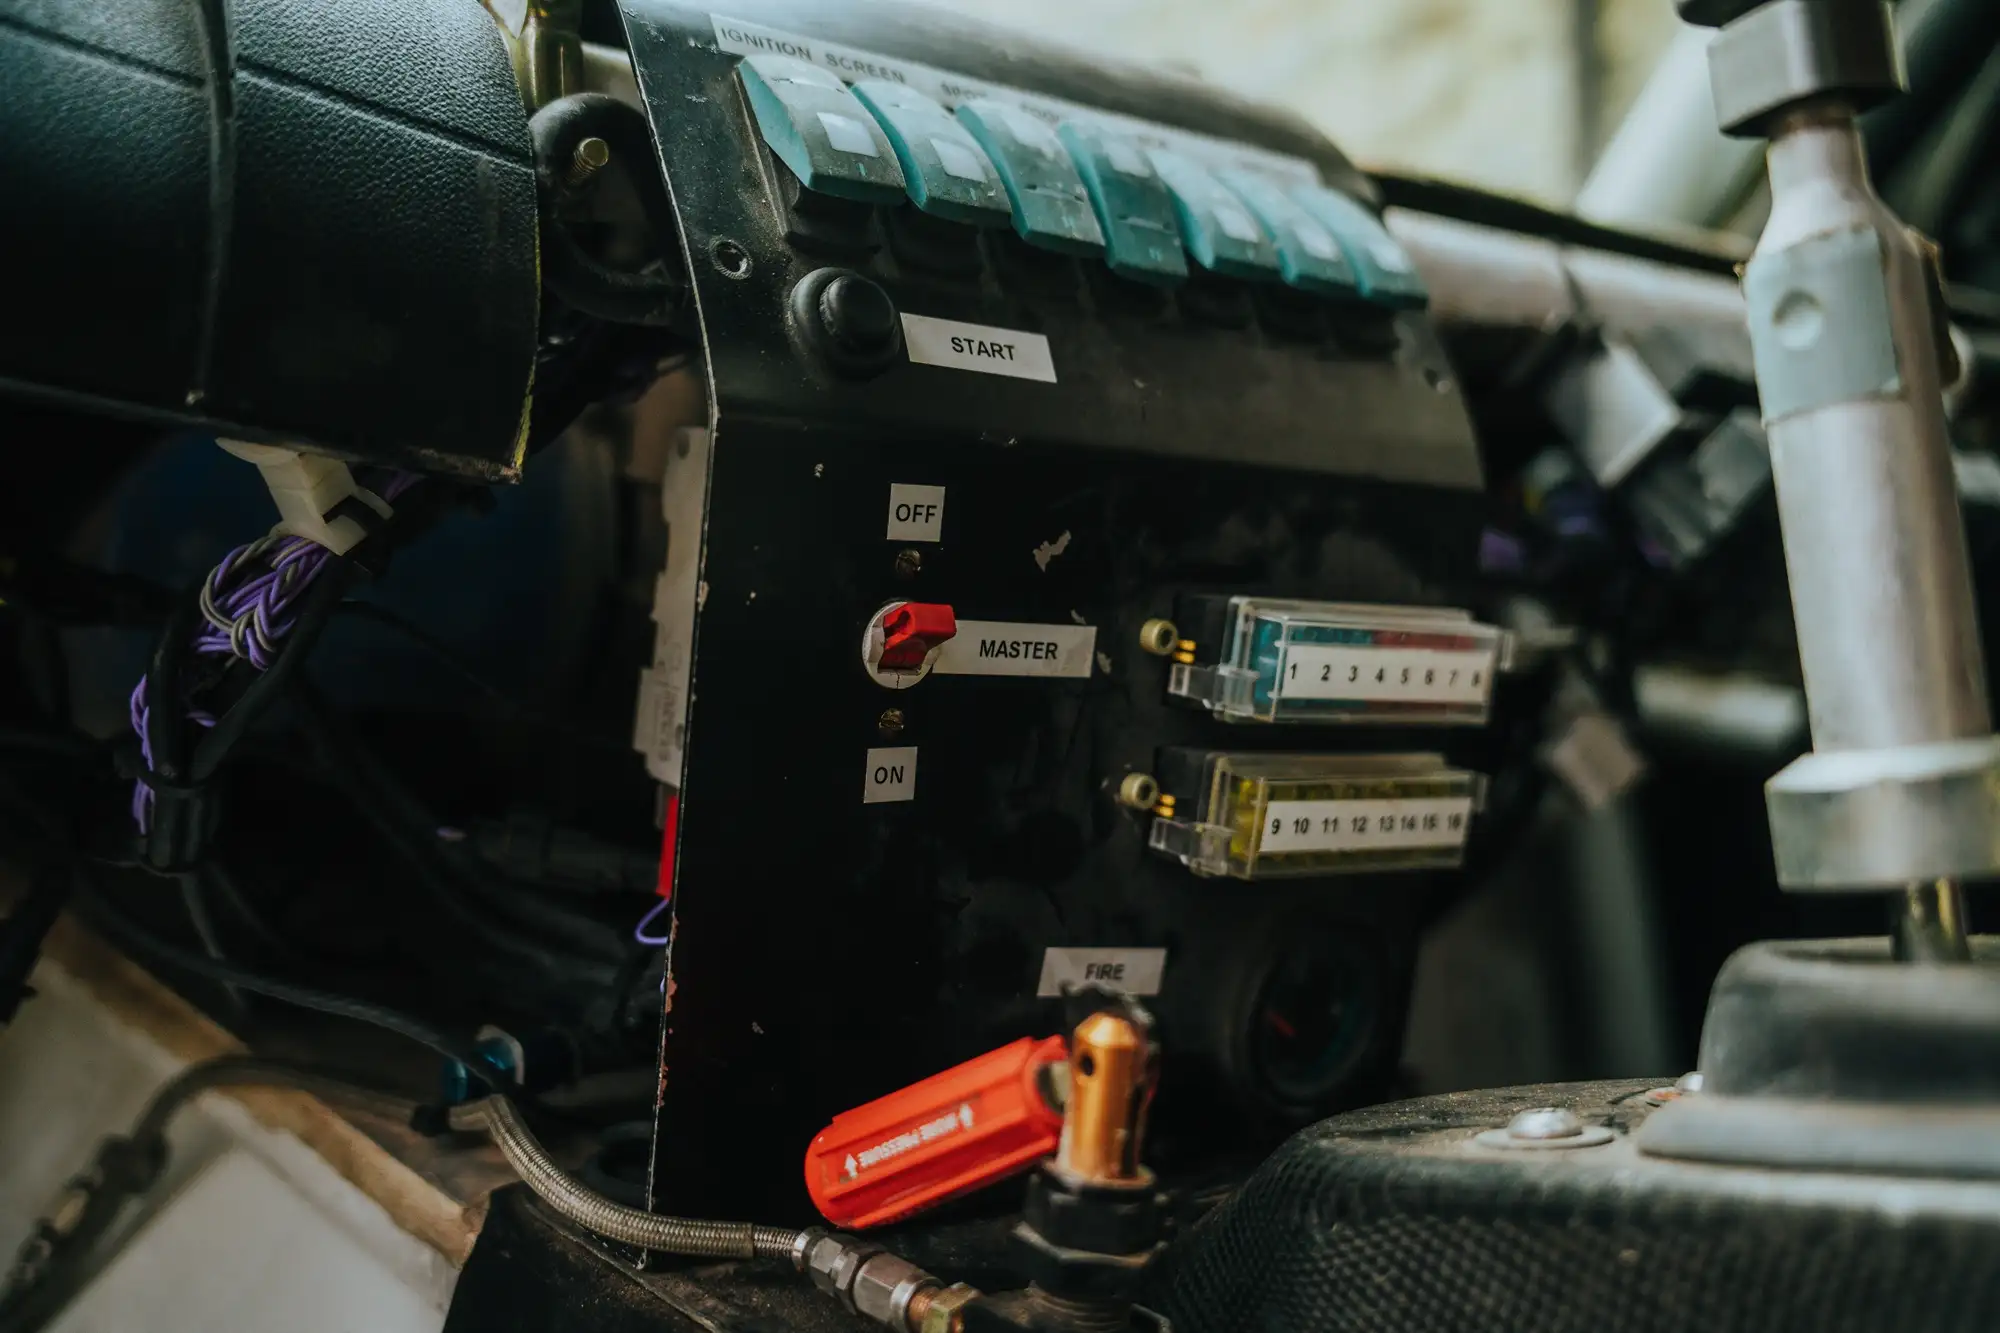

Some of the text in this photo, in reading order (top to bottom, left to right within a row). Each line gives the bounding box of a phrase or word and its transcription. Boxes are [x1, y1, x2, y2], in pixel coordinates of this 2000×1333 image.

[720, 27, 813, 61] IGNITION
[824, 53, 906, 84] SCREEN
[950, 335, 1016, 362] START
[895, 503, 938, 524] OFF
[979, 639, 1058, 661] MASTER
[1290, 663, 1298, 680] 1
[1320, 664, 1331, 682] 2
[1348, 665, 1358, 682] 3
[1375, 667, 1385, 683] 4
[1401, 667, 1411, 684] 5
[1425, 668, 1435, 685] 6
[1448, 669, 1460, 686] 7
[873, 766, 905, 785] ON
[1271, 813, 1462, 835] 9 10 11 12 13 14 15 16
[1085, 963, 1125, 981] FIRE
